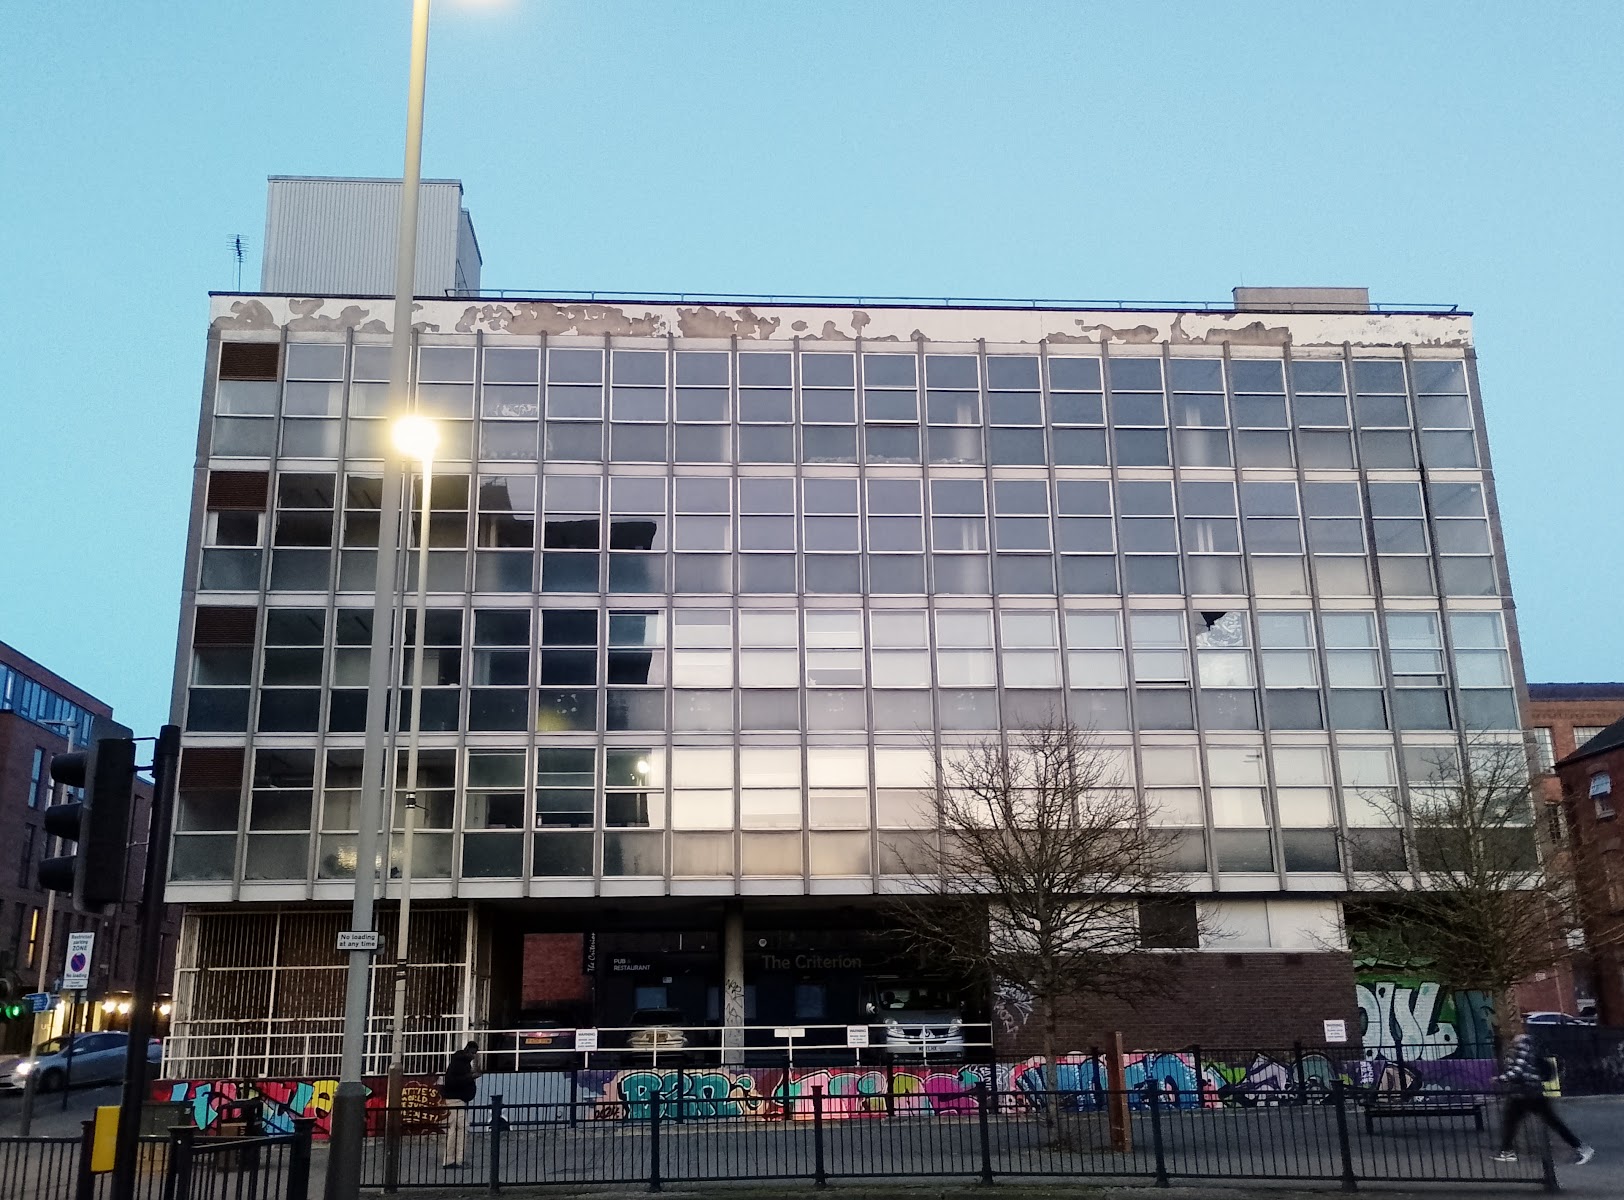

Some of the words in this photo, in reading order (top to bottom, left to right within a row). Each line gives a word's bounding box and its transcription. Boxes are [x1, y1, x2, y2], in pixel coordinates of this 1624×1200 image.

[761, 954, 791, 969] The
[795, 954, 862, 969] Criterion
[401, 1087, 438, 1098] ATTIE'S
